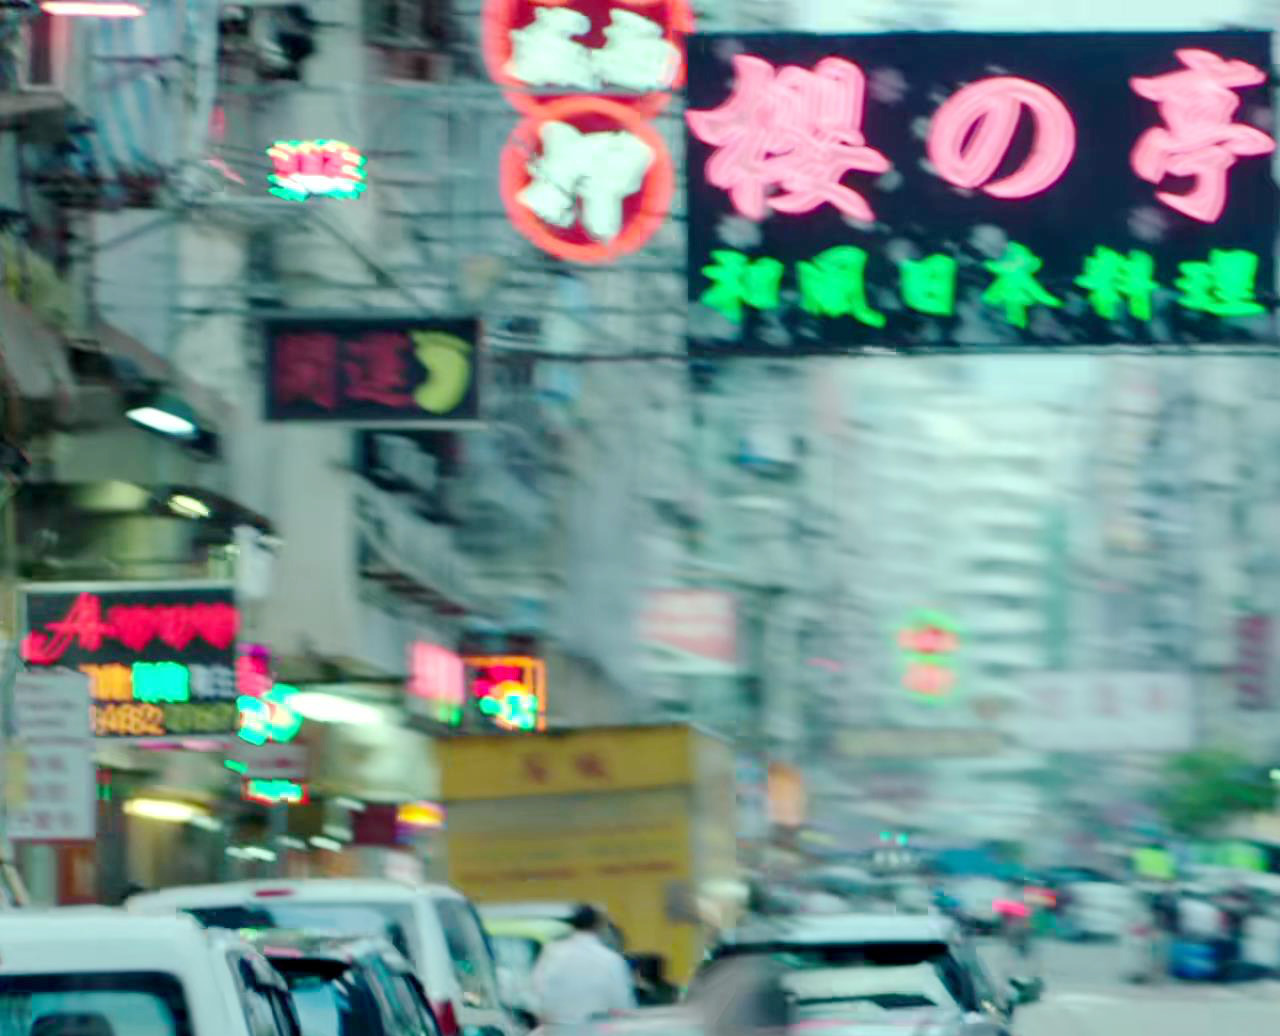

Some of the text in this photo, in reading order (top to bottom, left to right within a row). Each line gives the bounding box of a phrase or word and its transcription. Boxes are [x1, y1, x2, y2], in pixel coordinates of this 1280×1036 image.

[700, 241, 1266, 328] 和風日本料理
